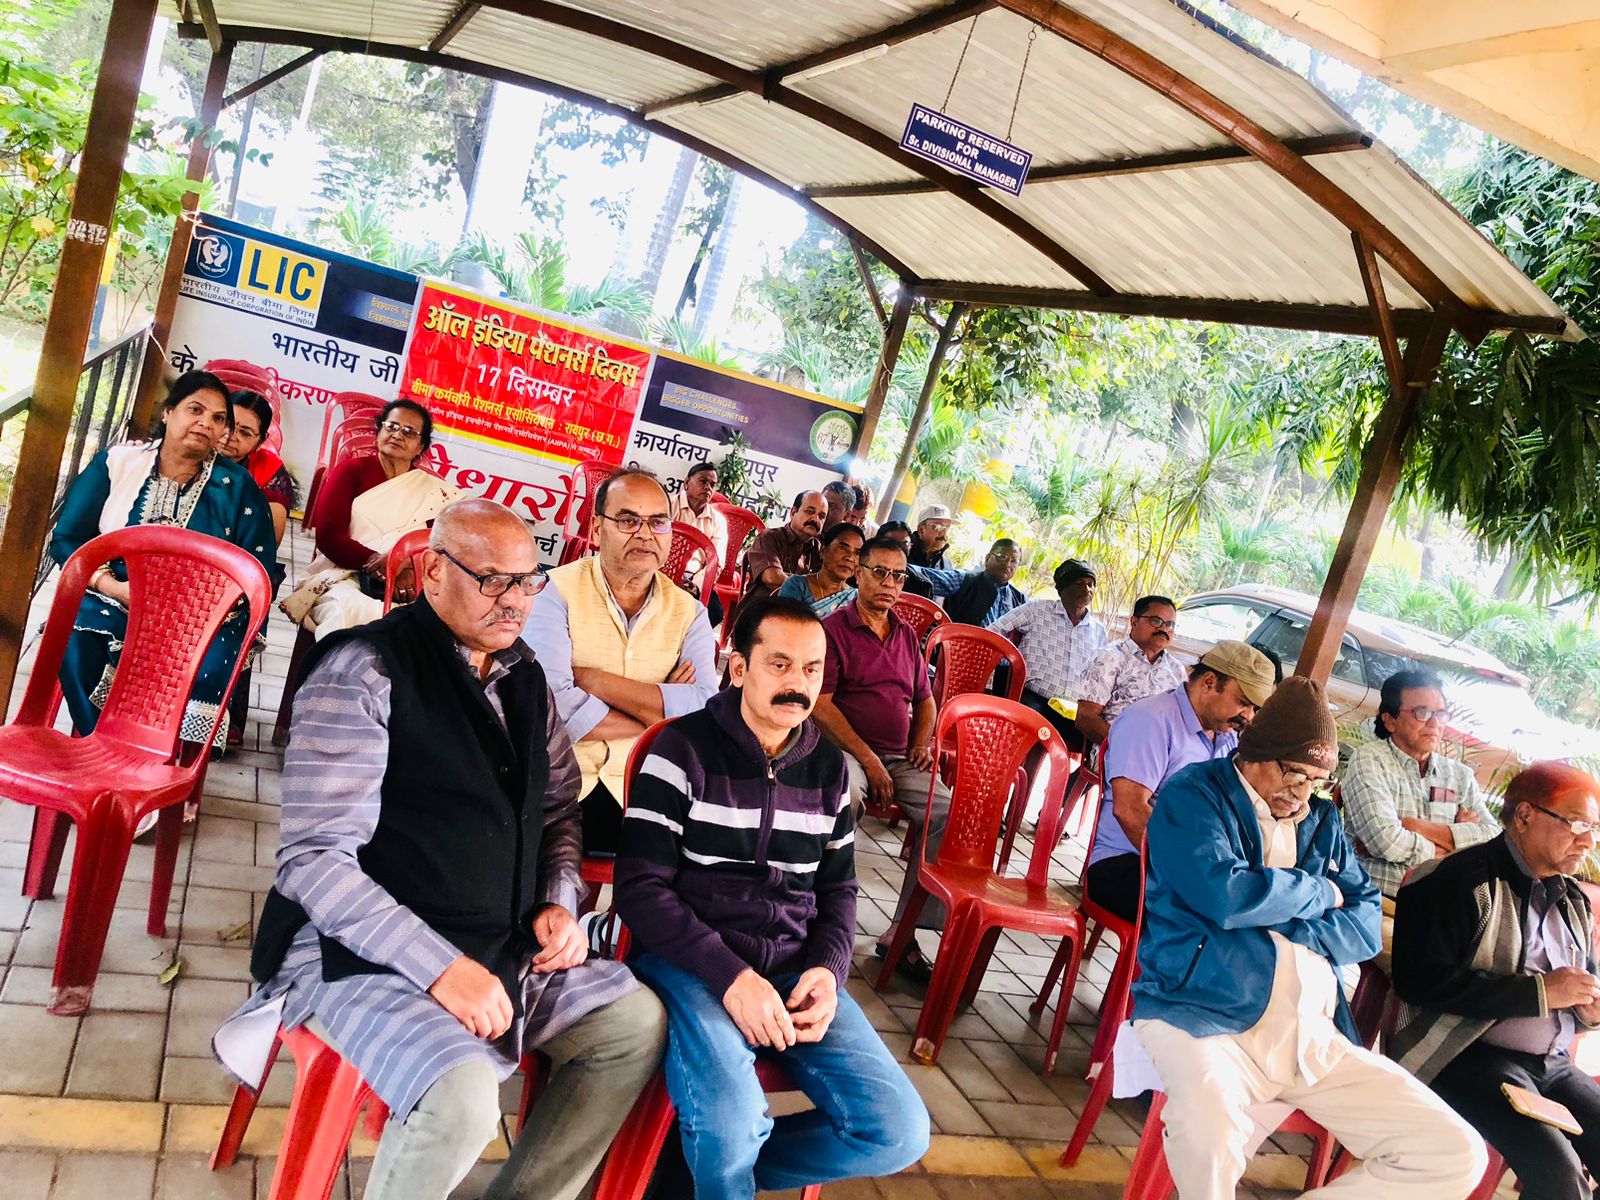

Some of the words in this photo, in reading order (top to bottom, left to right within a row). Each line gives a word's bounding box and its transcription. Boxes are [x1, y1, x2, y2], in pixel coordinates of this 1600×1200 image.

[908, 134, 920, 148] Sr.
[922, 140, 973, 171] DIVISIONAL
[974, 162, 1017, 188] MANAGER
[915, 111, 966, 140] PARKING
[968, 134, 1025, 166] RESERVED
[956, 141, 980, 159] FOR
[182, 277, 221, 293] भारतीय
[226, 288, 255, 303] जीवन
[262, 298, 283, 311] बीमा
[289, 304, 315, 320] निगम
[248, 248, 315, 302] LIC
[180, 286, 194, 294] LIFE
[195, 289, 235, 304] INSURANCE
[236, 300, 284, 318] CORPORATION
[296, 317, 314, 326] INDIA
[272, 332, 361, 373] भारतीय
[369, 355, 399, 385] जी
[423, 300, 473, 340] ऑल
[471, 313, 529, 356] इंडिया
[529, 329, 593, 374] पेंशनर्स
[590, 345, 640, 388] दिवस
[411, 378, 433, 398] बीमा
[434, 387, 471, 407] कर्मचारी
[565, 422, 591, 441] रायपुर
[477, 363, 502, 387] 17
[506, 366, 576, 407] दिसम्बर
[662, 393, 690, 408] BIGGER
[692, 402, 749, 424] OPPORTUNITIES
[674, 386, 689, 396] BIG
[634, 430, 711, 464] कार्यालय
[743, 458, 779, 487] यपुर
